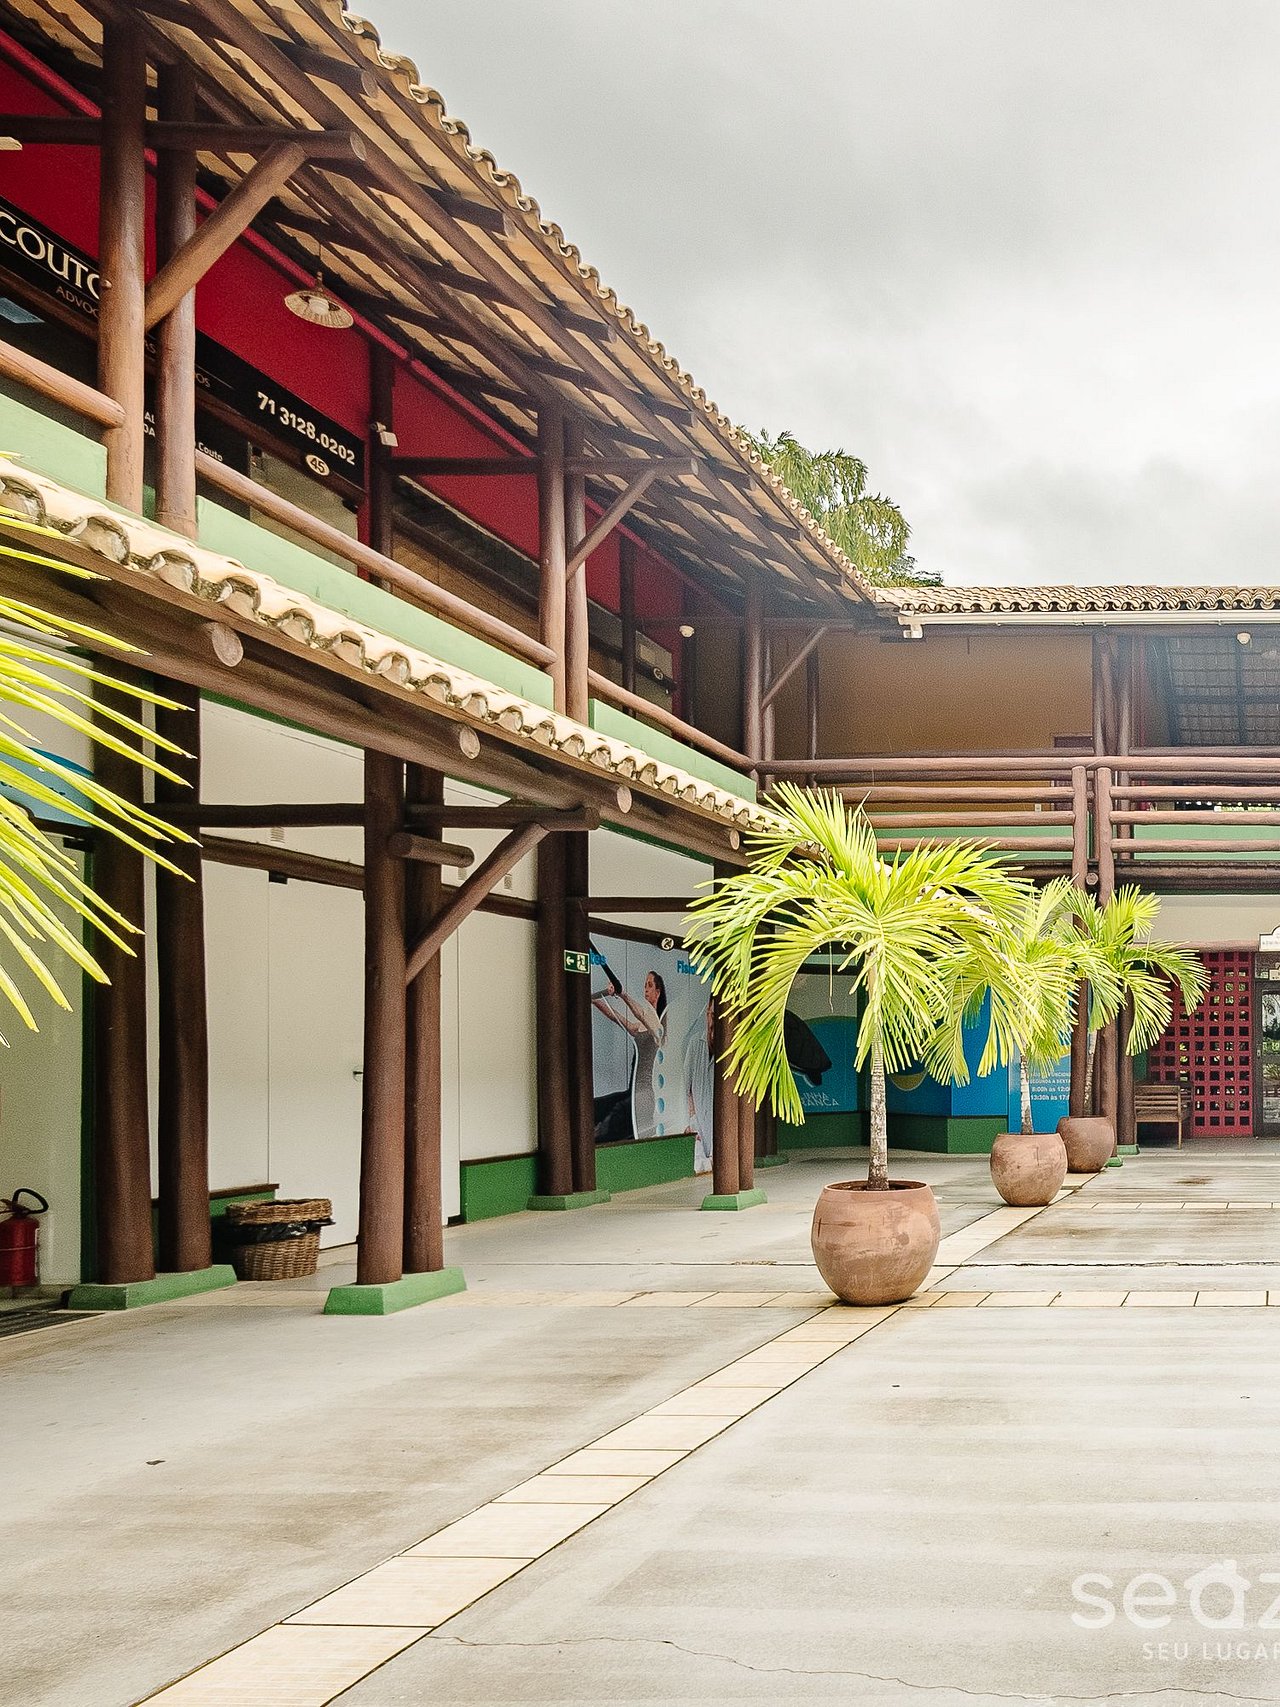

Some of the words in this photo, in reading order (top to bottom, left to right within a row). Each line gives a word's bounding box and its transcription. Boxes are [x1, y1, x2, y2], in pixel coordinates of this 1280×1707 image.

[257, 391, 276, 415] 71
[280, 406, 355, 466] 3128.0202
[310, 457, 325, 473] 45
